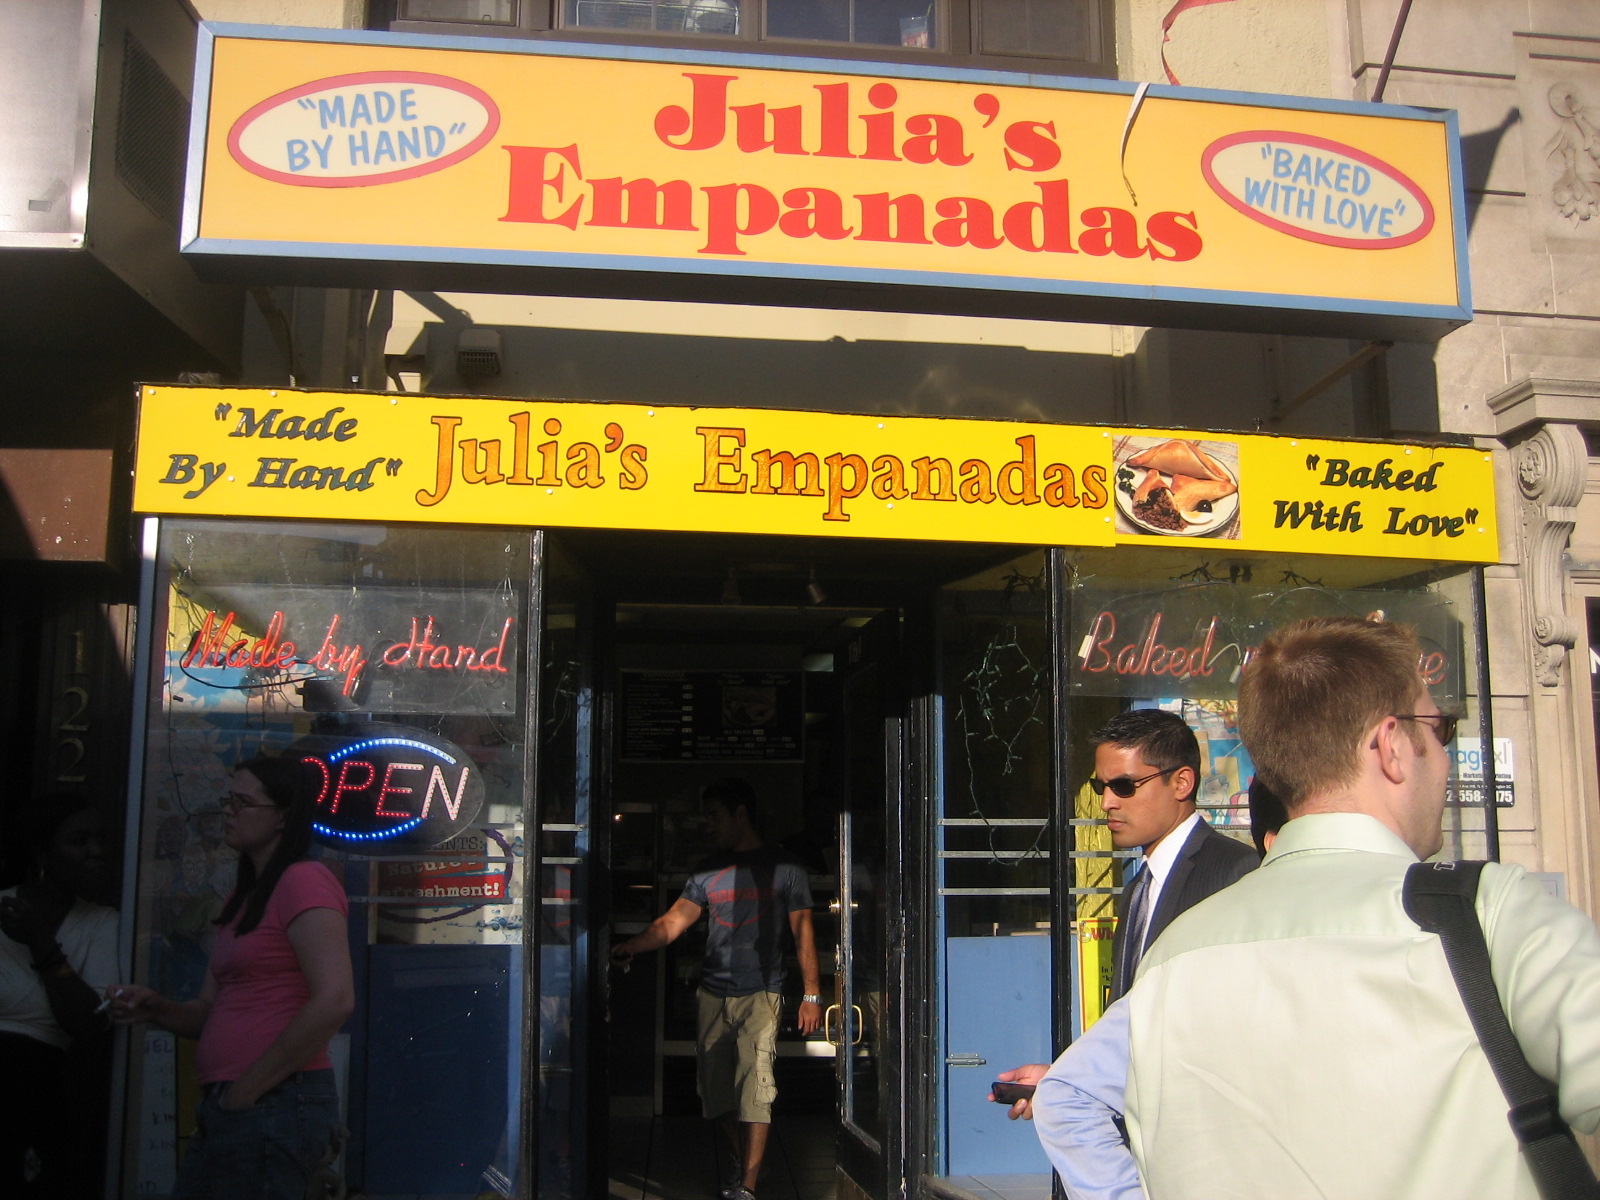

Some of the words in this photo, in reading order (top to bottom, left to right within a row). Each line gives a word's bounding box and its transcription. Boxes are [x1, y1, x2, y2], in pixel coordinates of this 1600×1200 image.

[286, 135, 333, 172] BY
[655, 73, 1062, 172] Julia's
[499, 143, 1203, 262] Empanadas
[1245, 177, 1315, 221] WITH
[158, 453, 227, 500] By
[415, 411, 649, 508] Julia's
[694, 426, 1108, 523] Empanadas
[1273, 500, 1364, 533] With
[183, 610, 296, 668] Made
[308, 614, 366, 695] by
[384, 616, 513, 673] Hand
[1081, 611, 1216, 677] Baked
